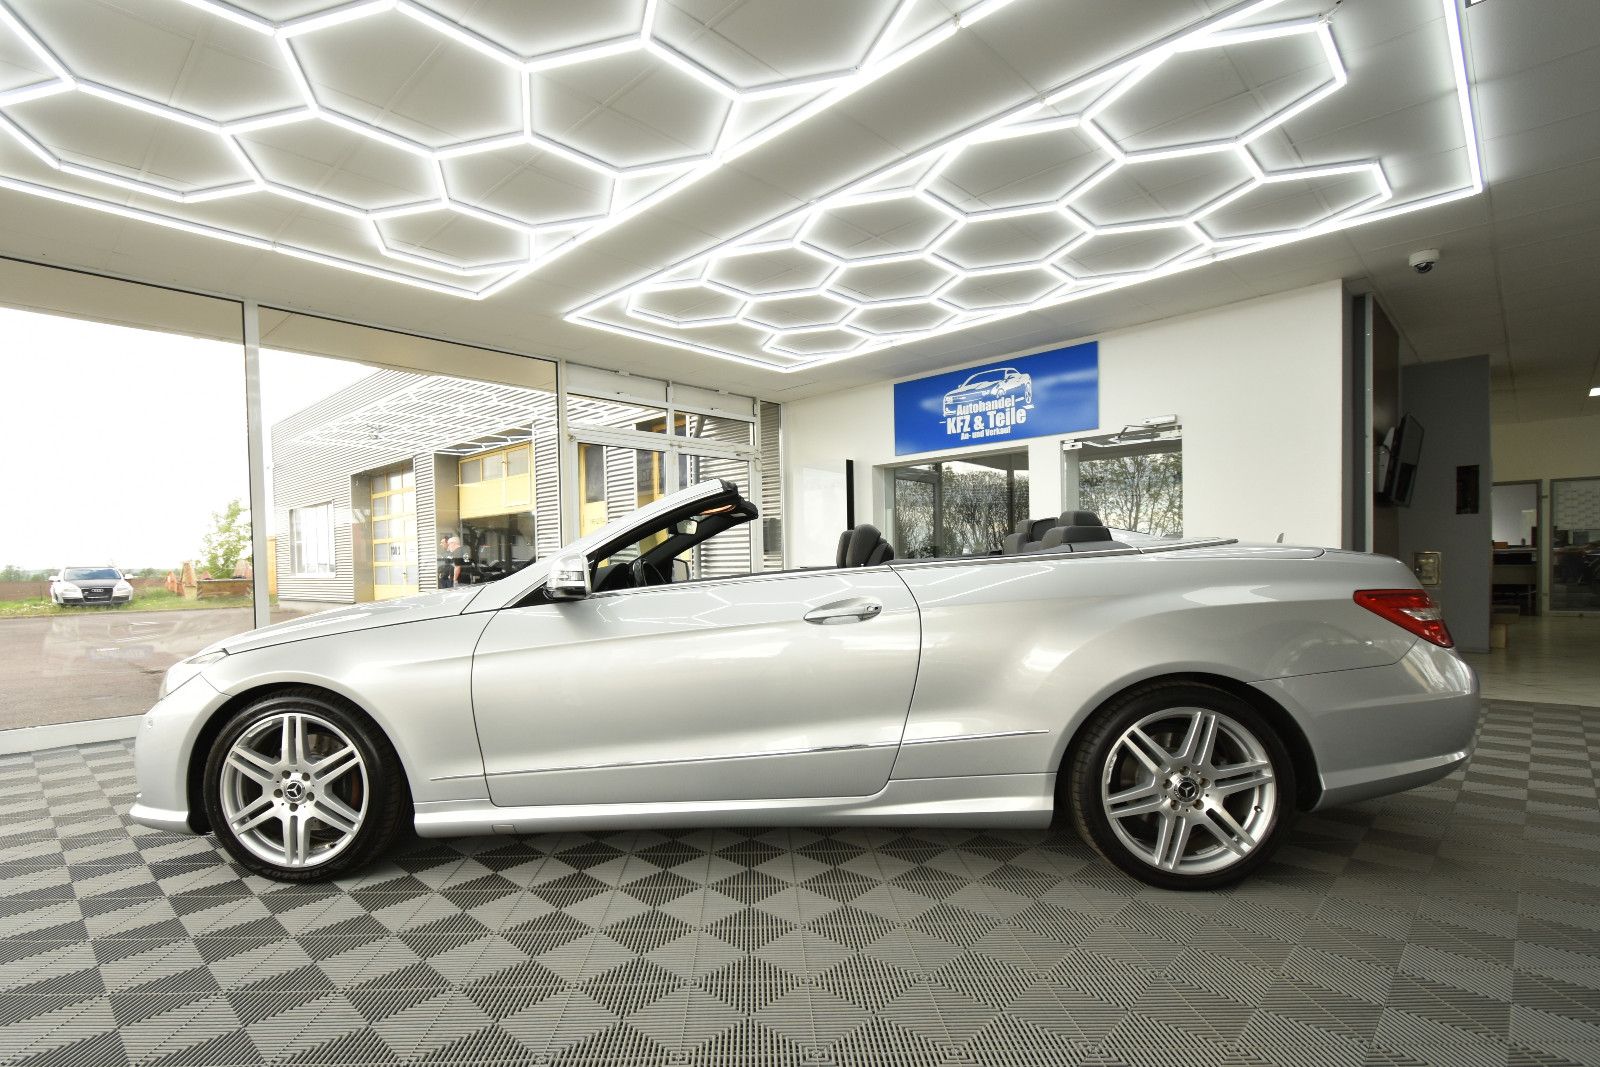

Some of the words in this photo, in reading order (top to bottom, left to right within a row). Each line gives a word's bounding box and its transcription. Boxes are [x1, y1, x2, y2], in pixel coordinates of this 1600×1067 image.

[957, 395, 1015, 416] Autohandel
[946, 415, 971, 434] KFZ
[974, 416, 985, 430] &
[987, 407, 1027, 428] Teile
[972, 430, 985, 439] und
[985, 426, 1011, 437] Verkauf
